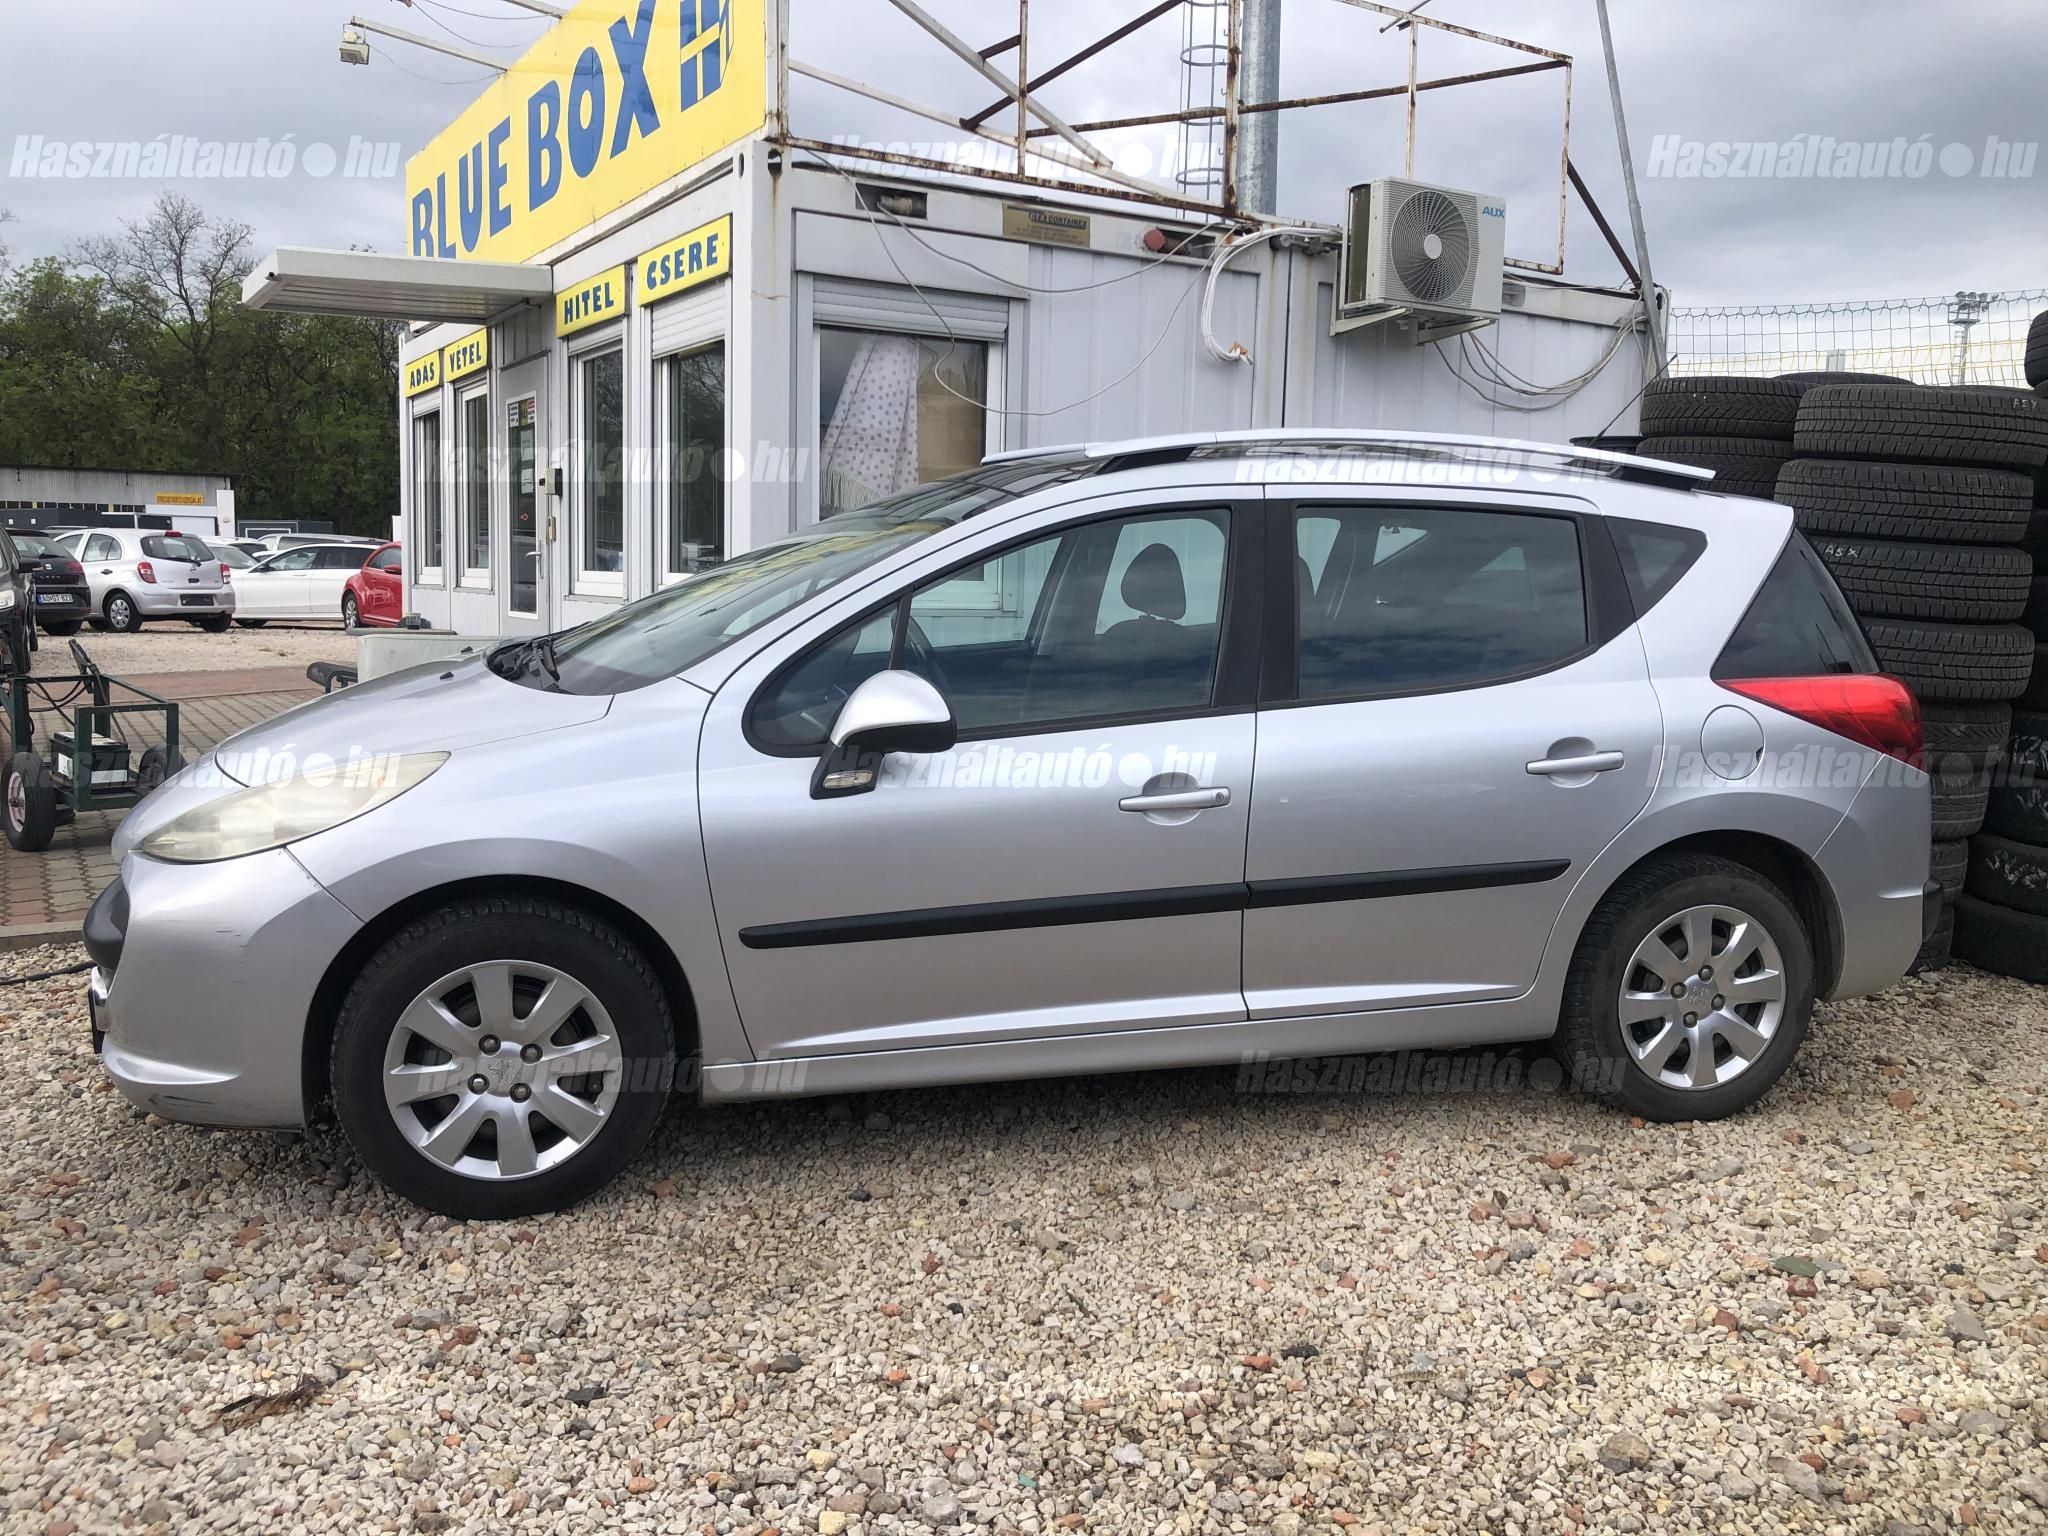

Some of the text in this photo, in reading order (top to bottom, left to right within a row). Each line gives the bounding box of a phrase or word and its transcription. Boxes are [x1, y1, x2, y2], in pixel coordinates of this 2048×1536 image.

[412, 0, 660, 259] BLUE BOX
[1482, 206, 1505, 219] AUX
[646, 233, 719, 290] CSERE
[564, 282, 614, 325] HITEL
[410, 360, 435, 389] ADÁS
[449, 341, 482, 373] VÉTEL
